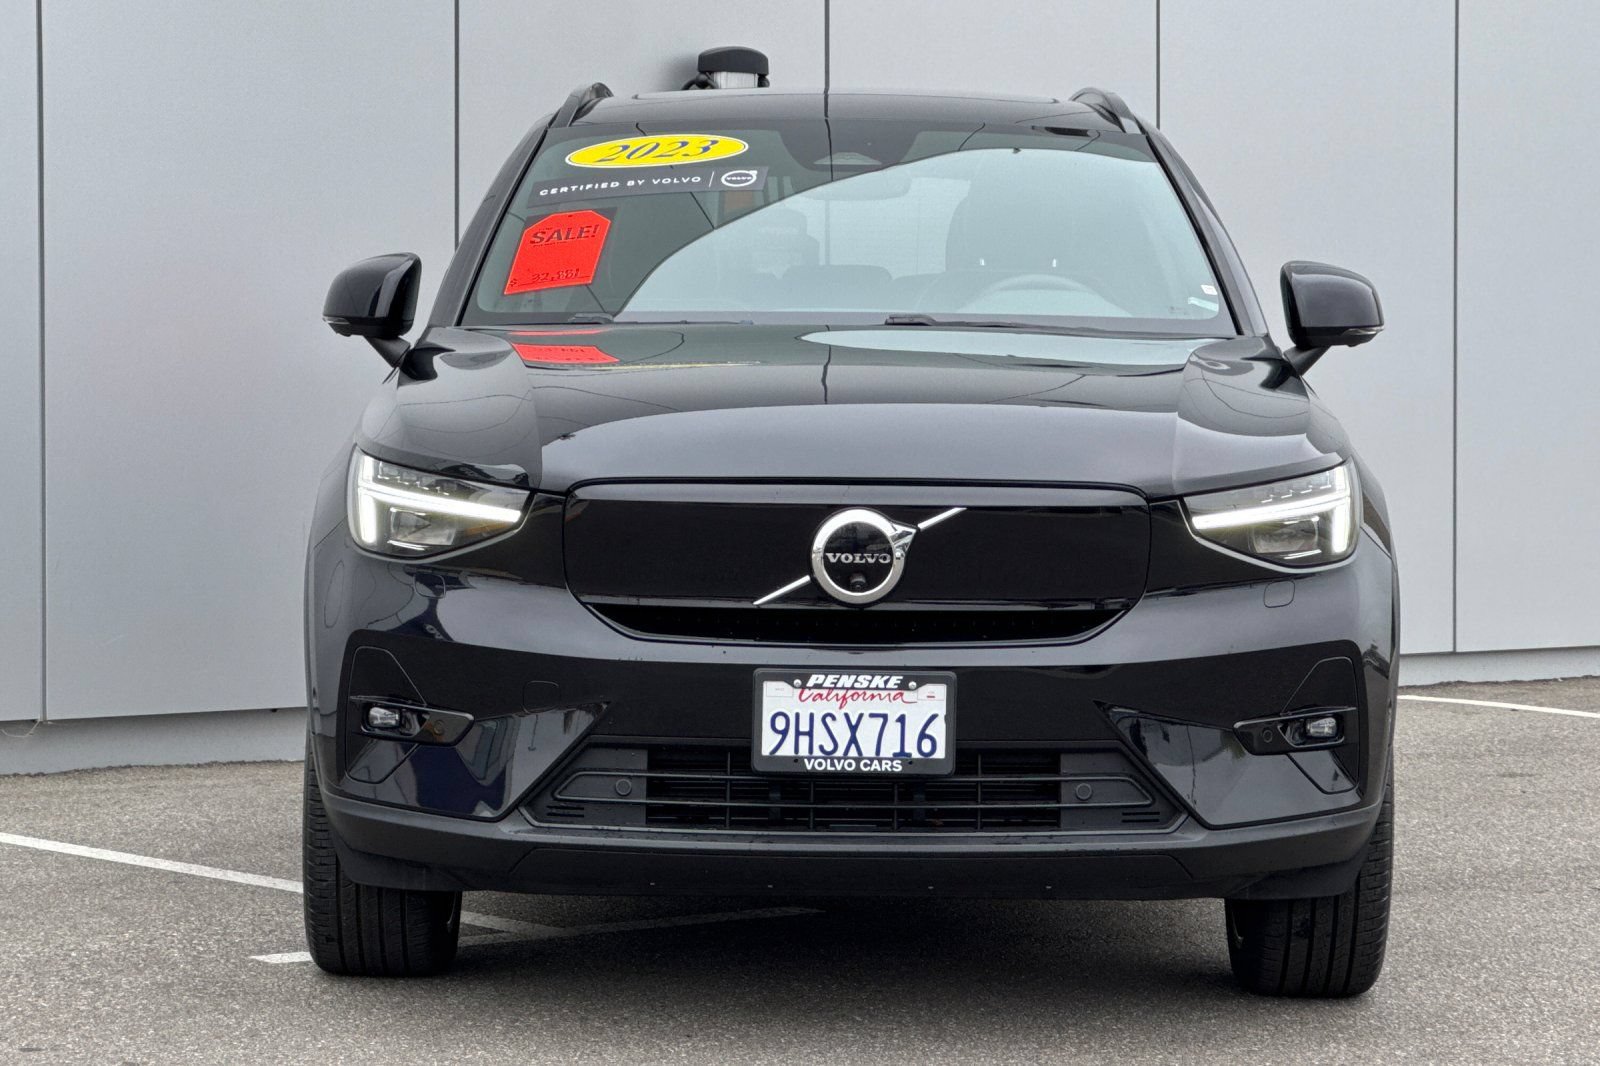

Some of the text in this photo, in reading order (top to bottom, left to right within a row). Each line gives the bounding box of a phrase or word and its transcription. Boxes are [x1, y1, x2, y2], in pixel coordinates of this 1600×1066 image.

[593, 139, 720, 163] 2023
[539, 175, 702, 196] CERTIFIED BY VOLVO
[529, 224, 600, 245] SALE!
[825, 552, 892, 564] VOLVO
[806, 674, 903, 689] PENSKE
[798, 688, 918, 710] California
[769, 711, 939, 758] 9HSX716
[804, 758, 903, 772] VOLVO CARS
